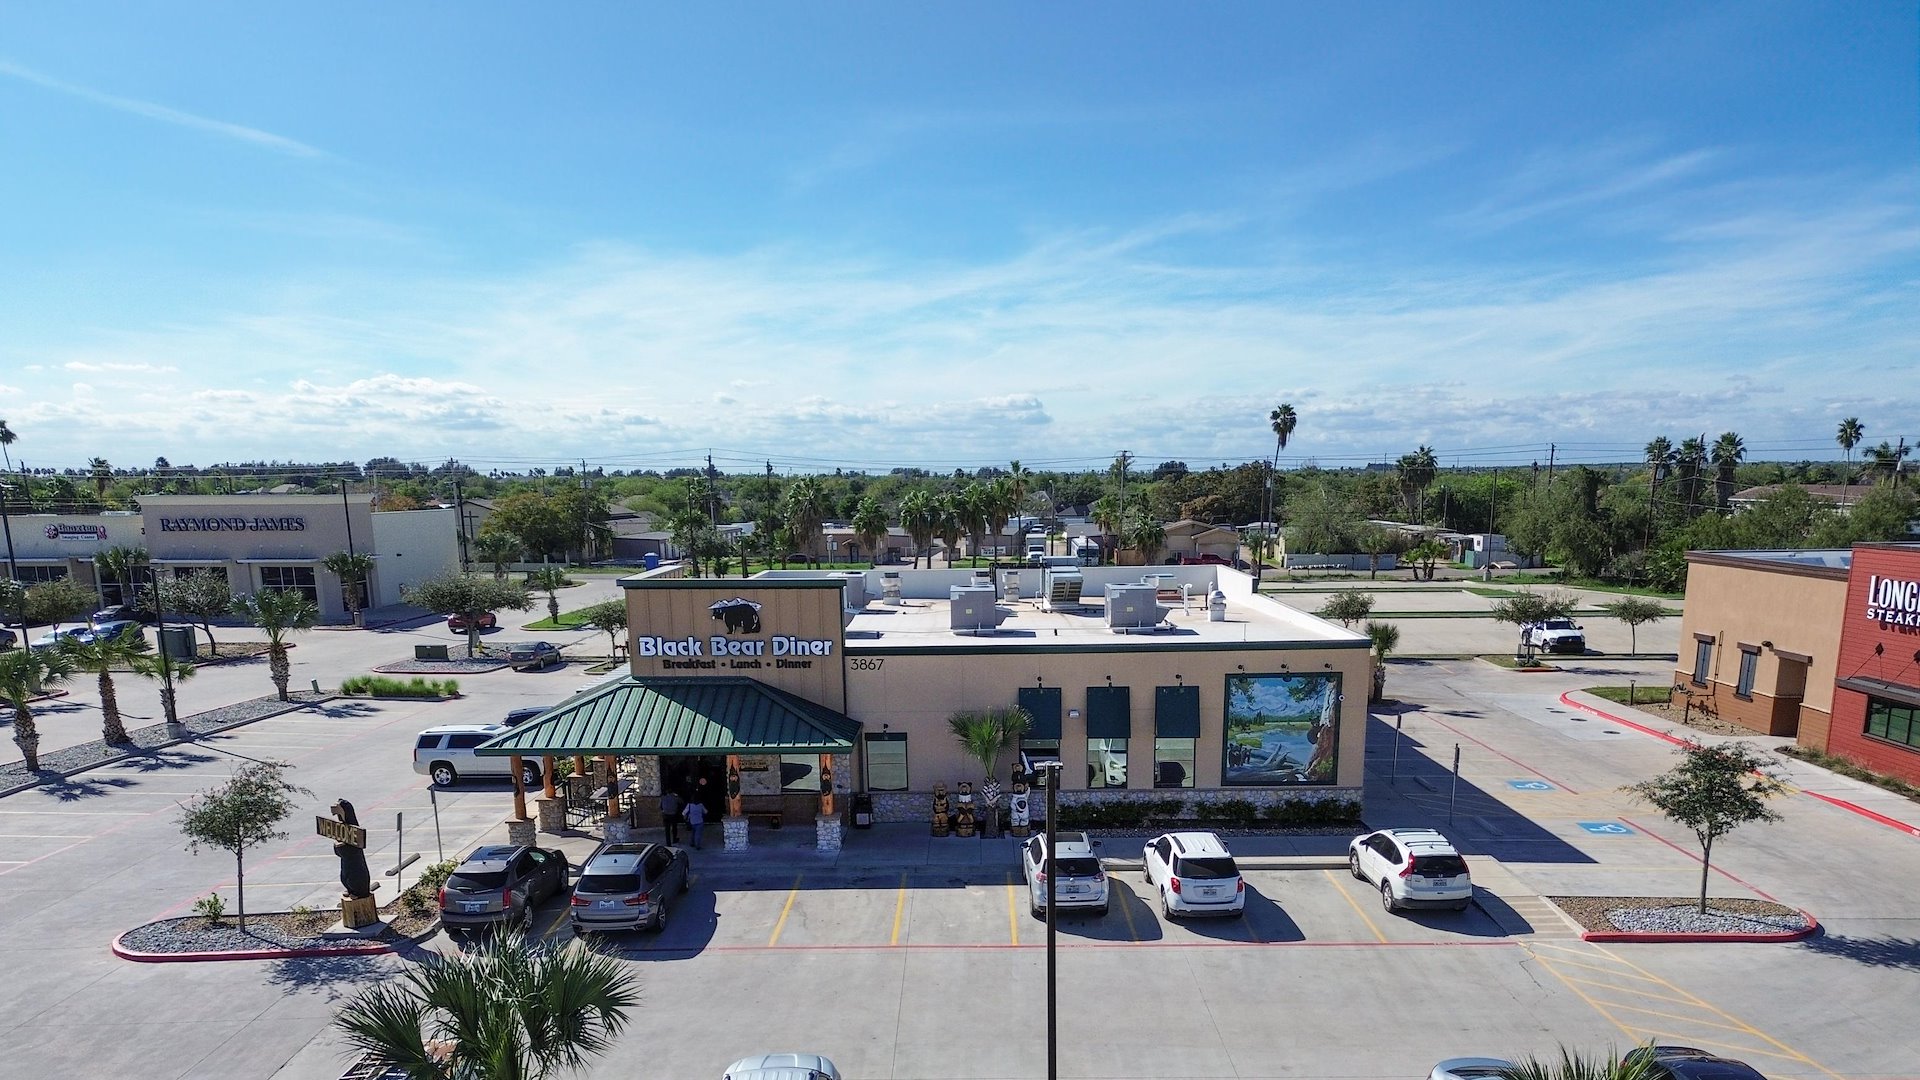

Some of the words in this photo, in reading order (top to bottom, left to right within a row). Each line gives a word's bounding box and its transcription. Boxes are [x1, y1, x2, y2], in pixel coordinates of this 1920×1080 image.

[160, 518, 246, 531] RAYMOND
[250, 517, 305, 531] JAMES
[1868, 575, 1920, 612] LONG
[638, 636, 702, 656] Black
[710, 636, 765, 656] Bear
[772, 636, 833, 656] Diner
[663, 658, 716, 669] Breakfast
[730, 658, 761, 669] Lunch
[776, 658, 812, 669] Dinner
[850, 658, 884, 671] 3867
[319, 819, 358, 846] WELCOME
